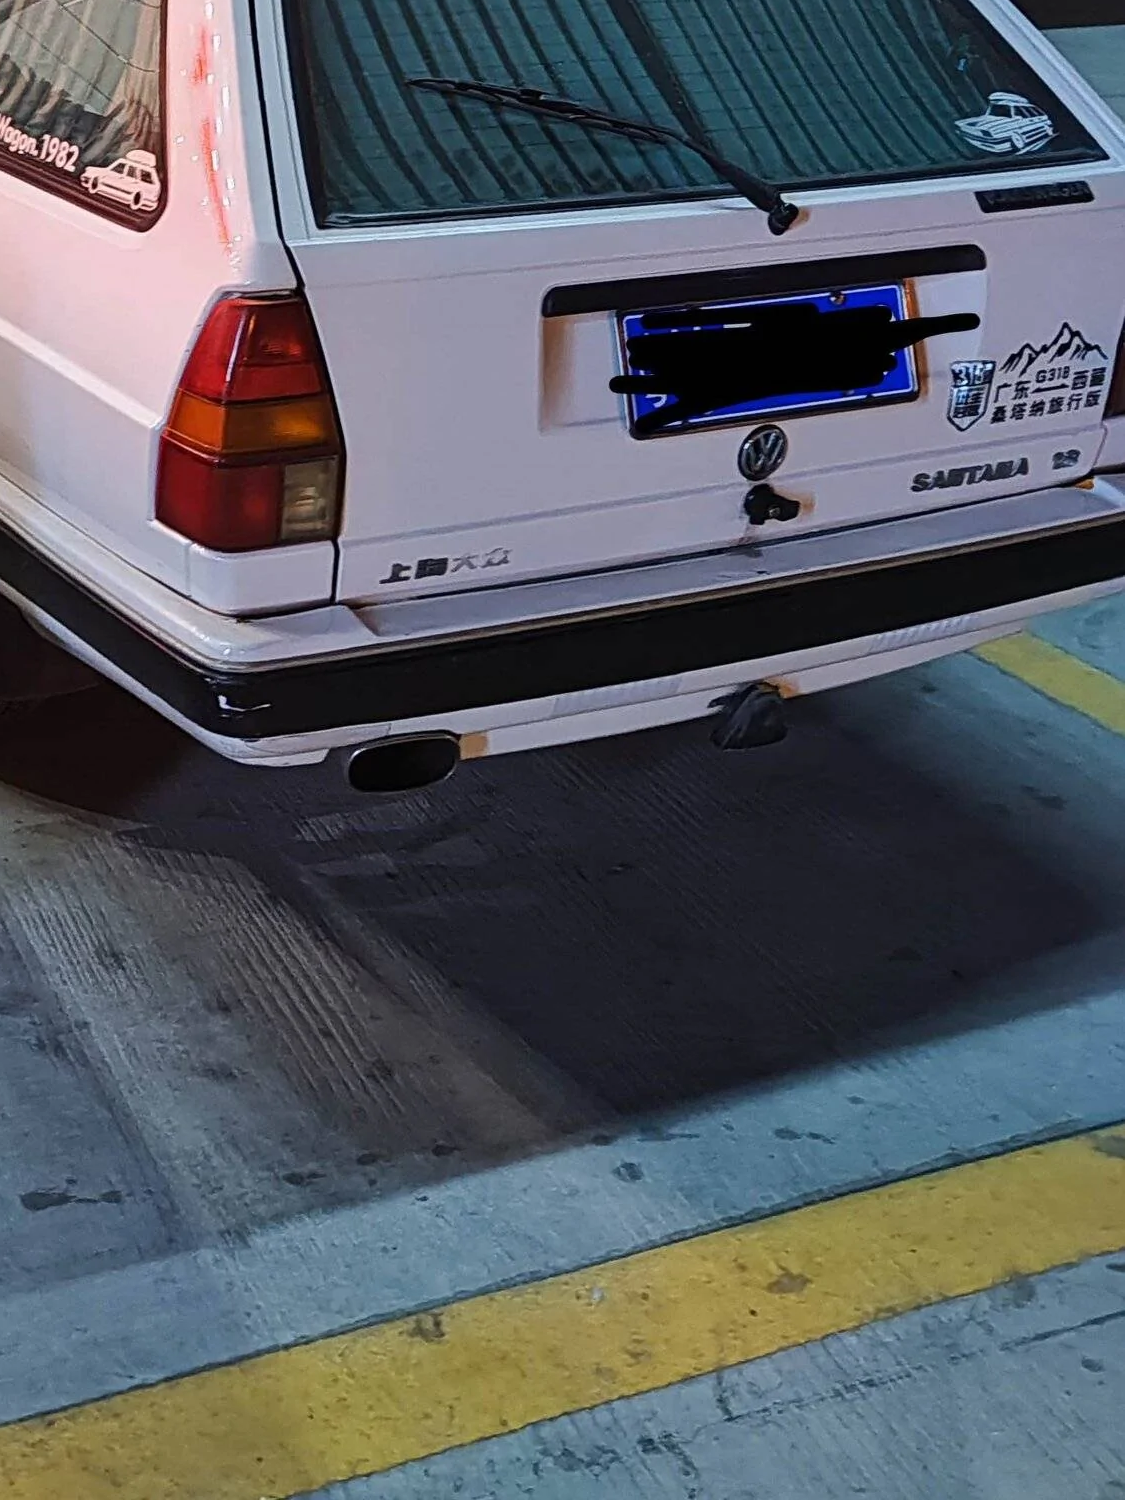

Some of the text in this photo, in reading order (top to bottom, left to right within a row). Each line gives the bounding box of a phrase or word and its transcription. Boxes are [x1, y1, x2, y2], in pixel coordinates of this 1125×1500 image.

[38, 133, 80, 173] 1982
[993, 380, 1032, 404] 广东
[1035, 366, 1071, 384] G318
